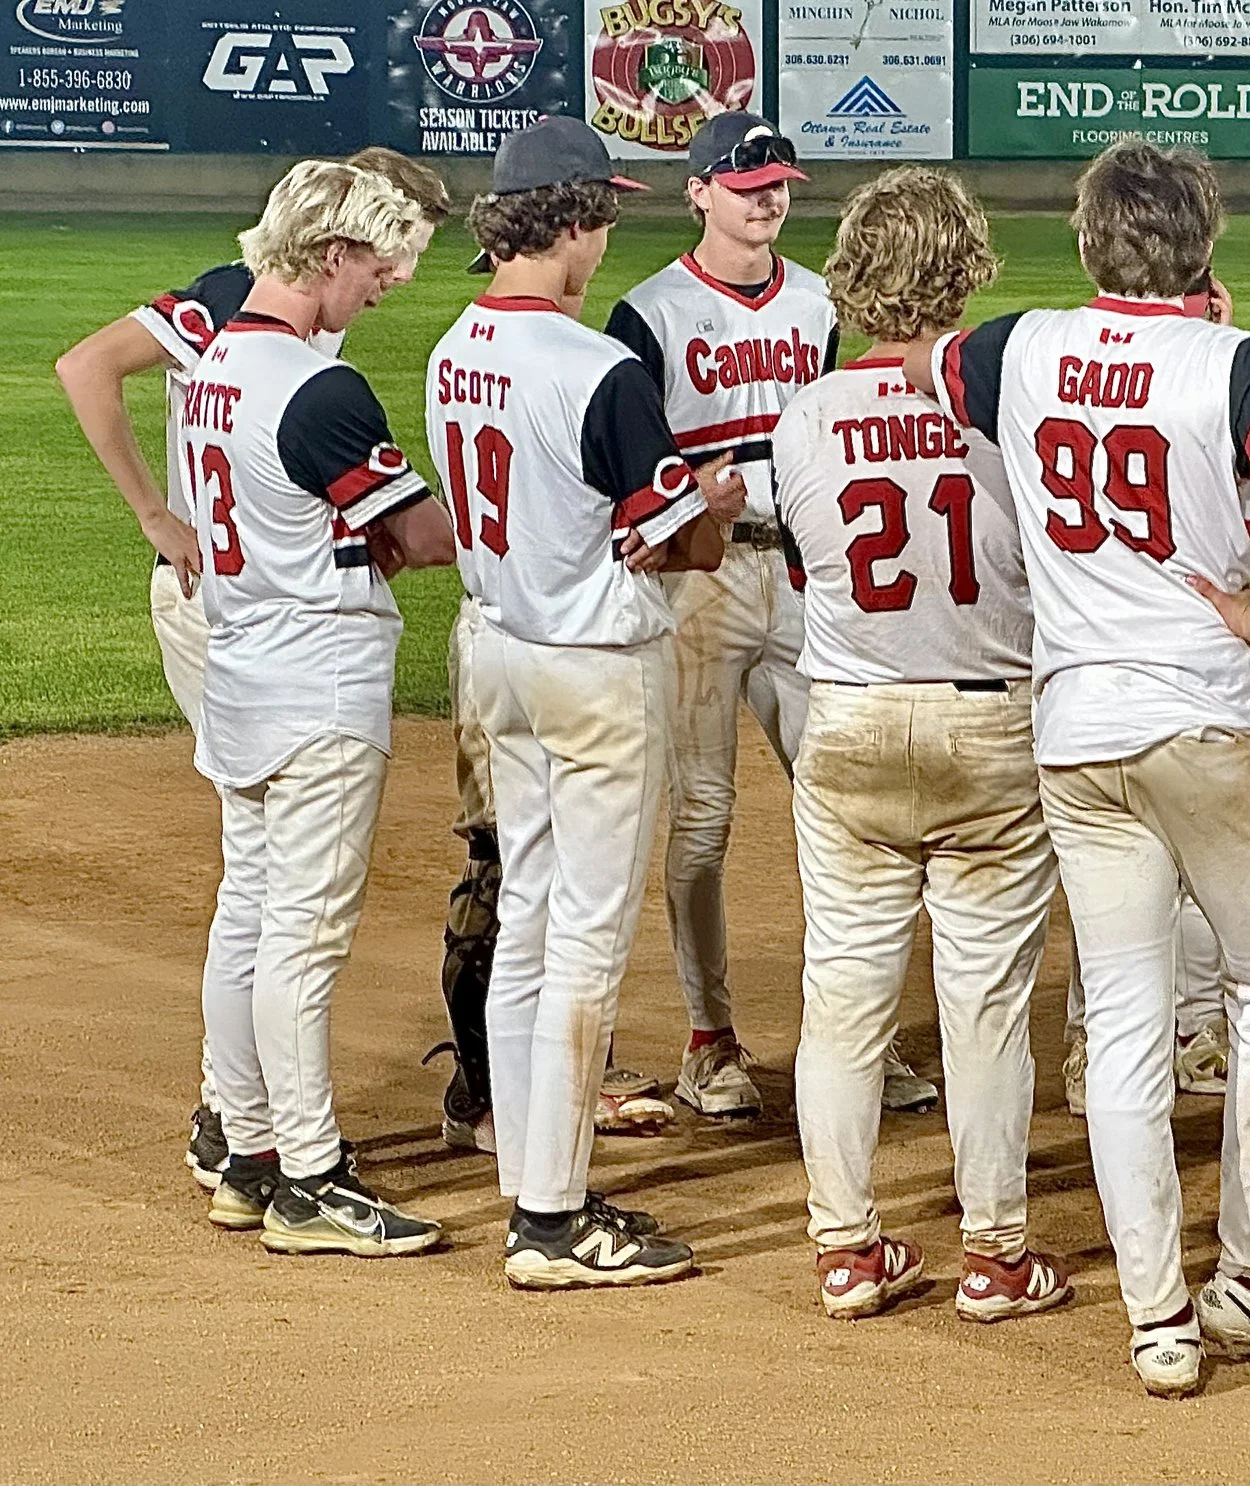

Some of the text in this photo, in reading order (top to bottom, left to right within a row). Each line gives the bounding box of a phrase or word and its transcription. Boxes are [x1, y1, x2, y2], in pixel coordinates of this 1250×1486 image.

[788, 7, 945, 21] MINCHIN NICHOL
[989, 0, 1131, 16] Megan Patterson
[1150, 0, 1189, 14] Hon.
[1193, 0, 1223, 14] Tim
[58, 18, 123, 33] Marketing
[600, 0, 743, 39] BUGSY'S
[988, 16, 1131, 27] MLA for Moose Jaw Wakamow
[1160, 18, 1182, 28] MLA
[1183, 18, 1197, 28] for
[1199, 18, 1231, 29] Moose
[1010, 34, 1097, 47] (306) 694-1001
[202, 32, 355, 95] GAP
[784, 54, 850, 66] 306.630.6231
[19, 68, 132, 90] 1-855-396-6830
[430, 60, 527, 99] WARRIORS
[1016, 81, 1114, 118] END
[1117, 100, 1140, 112] THE
[1120, 90, 1138, 100] OF
[419, 107, 538, 130] SEASON TICKETS
[801, 121, 931, 135] Ottawa Real Estate
[421, 130, 497, 152] AVAILABLE
[824, 135, 903, 149] & Insurance
[1072, 129, 1209, 144] FLOORING CENTRES
[685, 326, 819, 395] Canucks
[438, 358, 511, 411] SCOTT
[1057, 355, 1154, 409] GADD
[182, 379, 242, 434] RATTE
[831, 412, 970, 465] TONGE
[652, 455, 690, 499] C
[446, 421, 514, 562] 19
[1034, 416, 1177, 564] 99
[836, 473, 981, 614] 21
